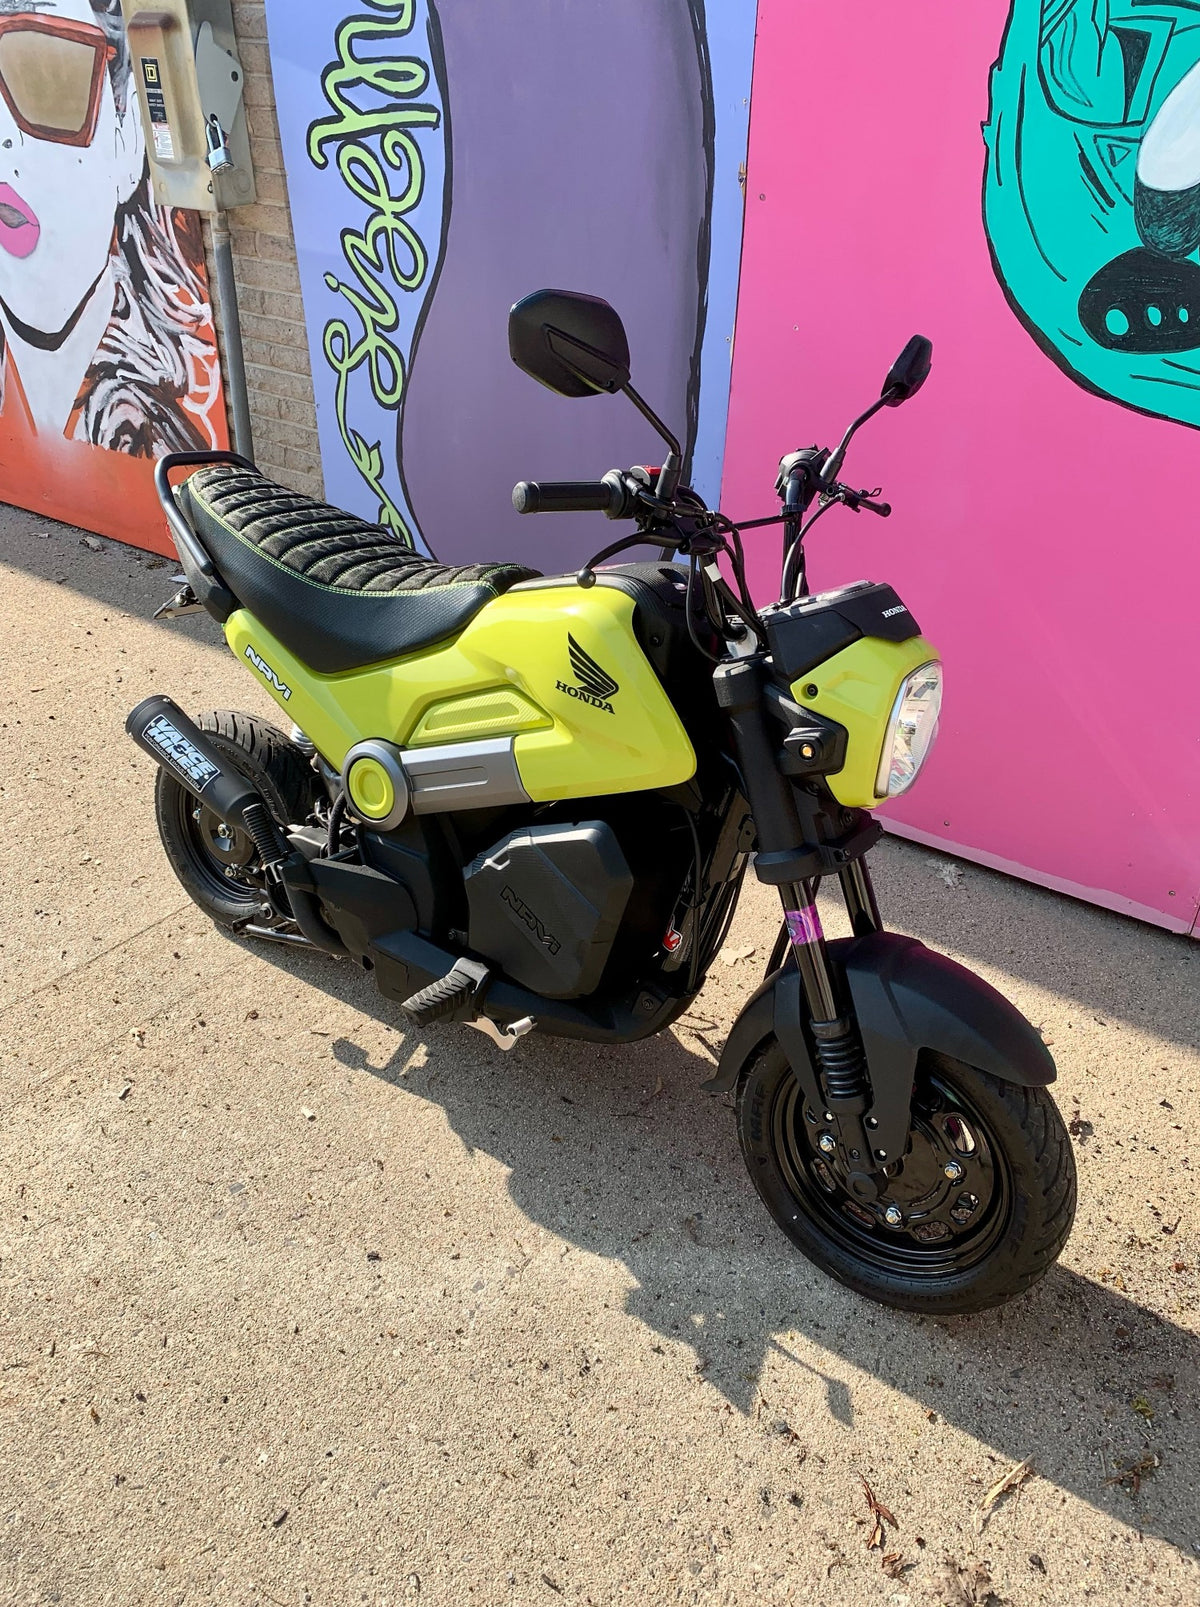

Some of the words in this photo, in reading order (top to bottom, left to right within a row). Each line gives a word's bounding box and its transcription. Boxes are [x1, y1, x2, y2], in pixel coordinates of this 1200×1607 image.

[881, 604, 908, 619] HONDA
[244, 644, 293, 702] NAVI
[555, 679, 616, 715] HONDA
[147, 727, 203, 780] HINES
[156, 719, 216, 774] VANCE
[500, 885, 562, 956] NAVI
